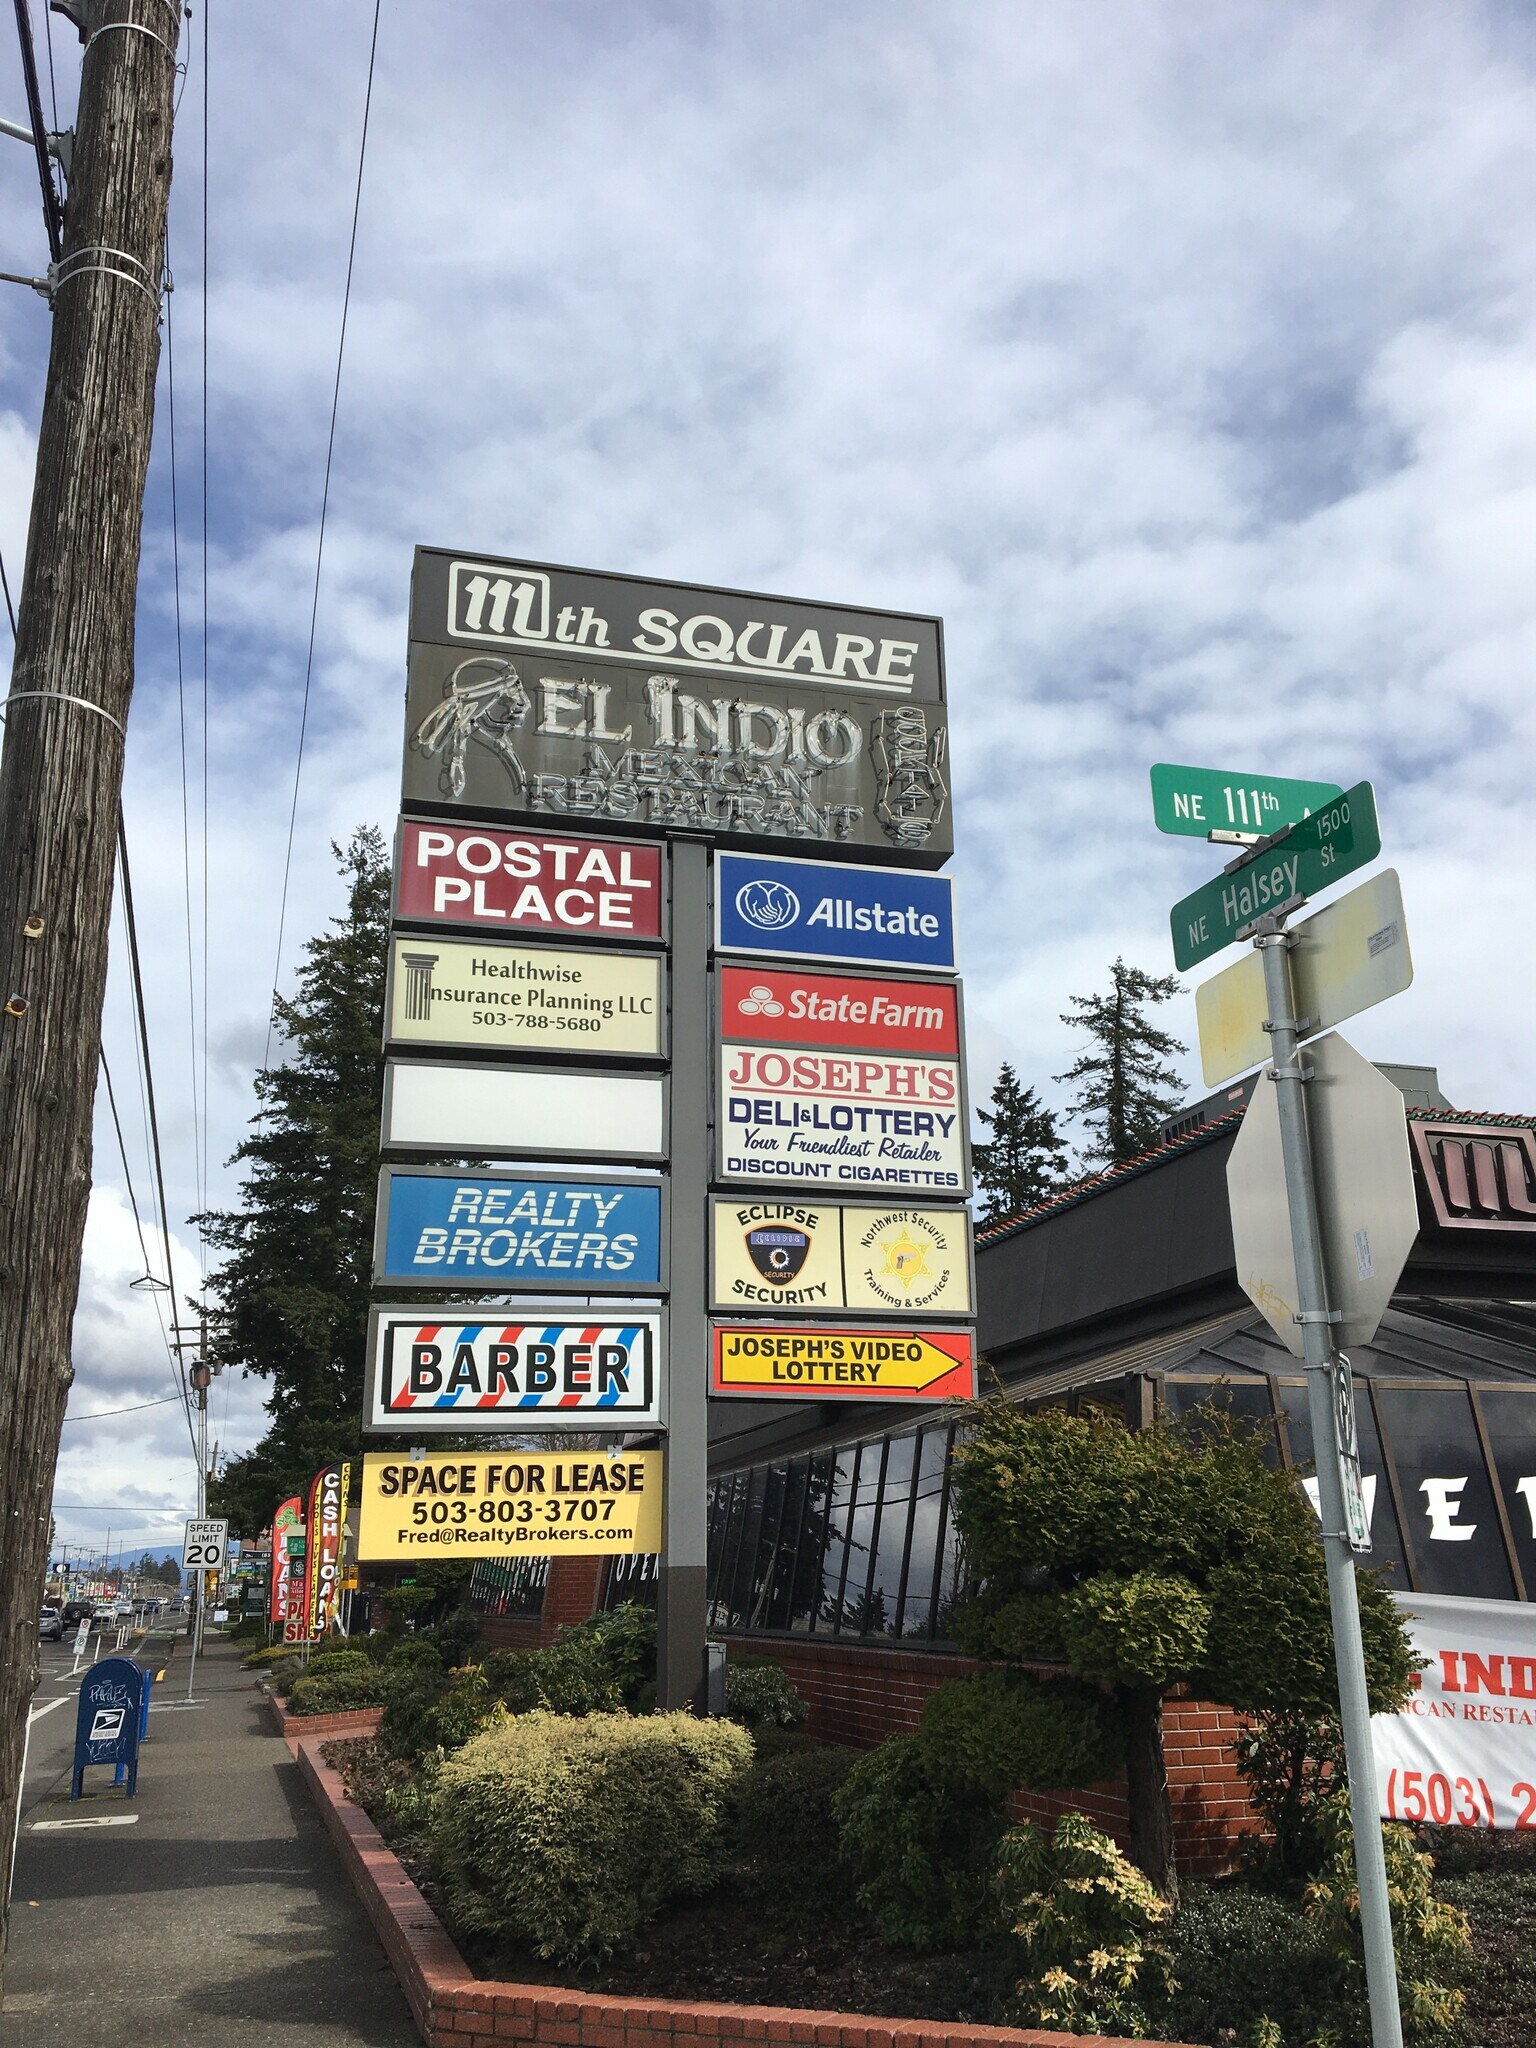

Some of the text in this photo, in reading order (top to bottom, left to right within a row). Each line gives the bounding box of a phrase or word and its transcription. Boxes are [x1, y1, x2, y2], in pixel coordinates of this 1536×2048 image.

[632, 607, 919, 684] SQUARE
[538, 674, 863, 766] EL INDIO
[588, 744, 824, 797] MEXICAN
[533, 771, 865, 832] RESTAURANT
[1173, 787, 1279, 826] NE 111th
[1316, 802, 1350, 840] 1500
[416, 830, 652, 888] POSTAL
[433, 876, 634, 929] PLACE
[1188, 843, 1335, 948] NE Halsey St
[806, 897, 939, 938] Allstate
[471, 958, 582, 983] Healthwise
[472, 1011, 601, 1032] 503-788-5680
[527, 989, 613, 1018] Planning
[618, 996, 653, 1015] LLC
[728, 1051, 956, 1100] JOSEPH'S
[743, 1127, 942, 1162] Your Friendliest Retailer
[727, 1157, 959, 1187] DISCOUNT CIGARETTES
[447, 1187, 624, 1228] REALTY
[736, 1204, 819, 1230] ECLIPSE
[413, 1228, 638, 1270] BROKERS
[860, 1210, 948, 1251] Northwest Security
[731, 1278, 828, 1305] SECURITY
[863, 1268, 950, 1308] Training & Services
[410, 1344, 630, 1393] BARBER
[850, 1341, 923, 1362] VIDEO
[772, 1361, 882, 1382] LOTTERY
[381, 1463, 645, 1495] SPACE FOR LEASE
[322, 1473, 340, 1537] CASH
[412, 1499, 616, 1525] 503-803-3707
[189, 1524, 223, 1533] SPEED
[192, 1535, 219, 1543] LIMIT
[397, 1527, 633, 1545] Fred@RealtyBrokers.com
[186, 1545, 220, 1564] 20
[1463, 1704, 1536, 1726] RESTA
[1387, 1768, 1495, 1829] (503)
